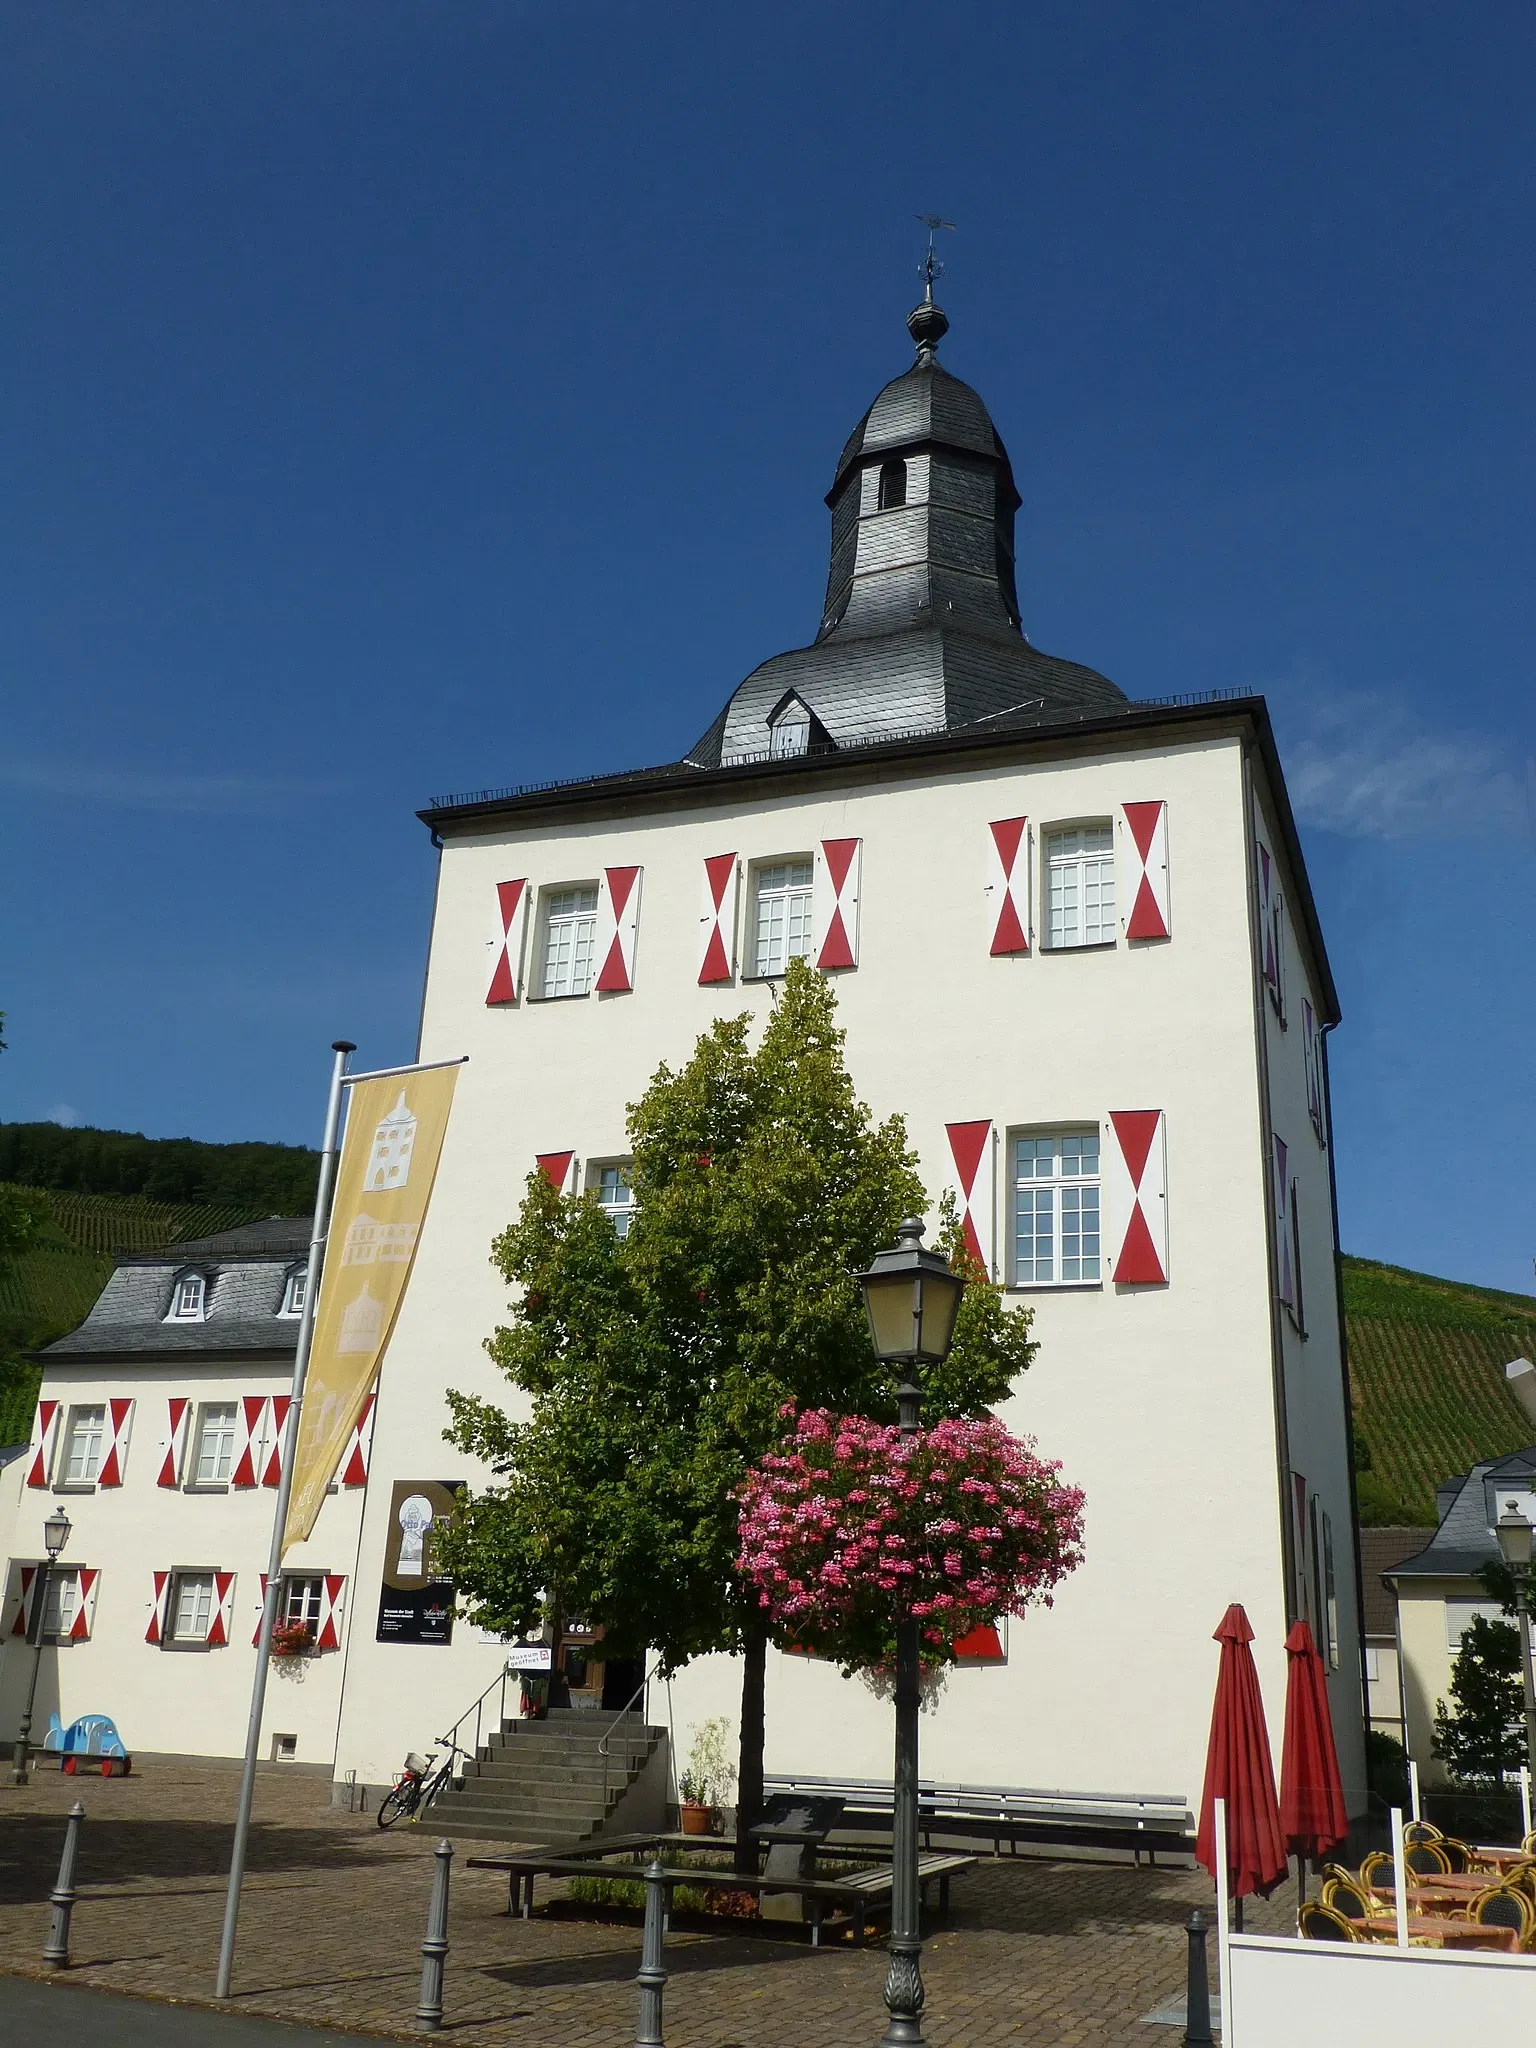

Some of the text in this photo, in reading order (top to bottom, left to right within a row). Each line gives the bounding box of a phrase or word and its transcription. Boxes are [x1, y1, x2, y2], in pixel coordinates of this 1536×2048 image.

[401, 1519, 418, 1529] Otto
[509, 1652, 538, 1660] Museum
[510, 1657, 539, 1667] geöffnet
